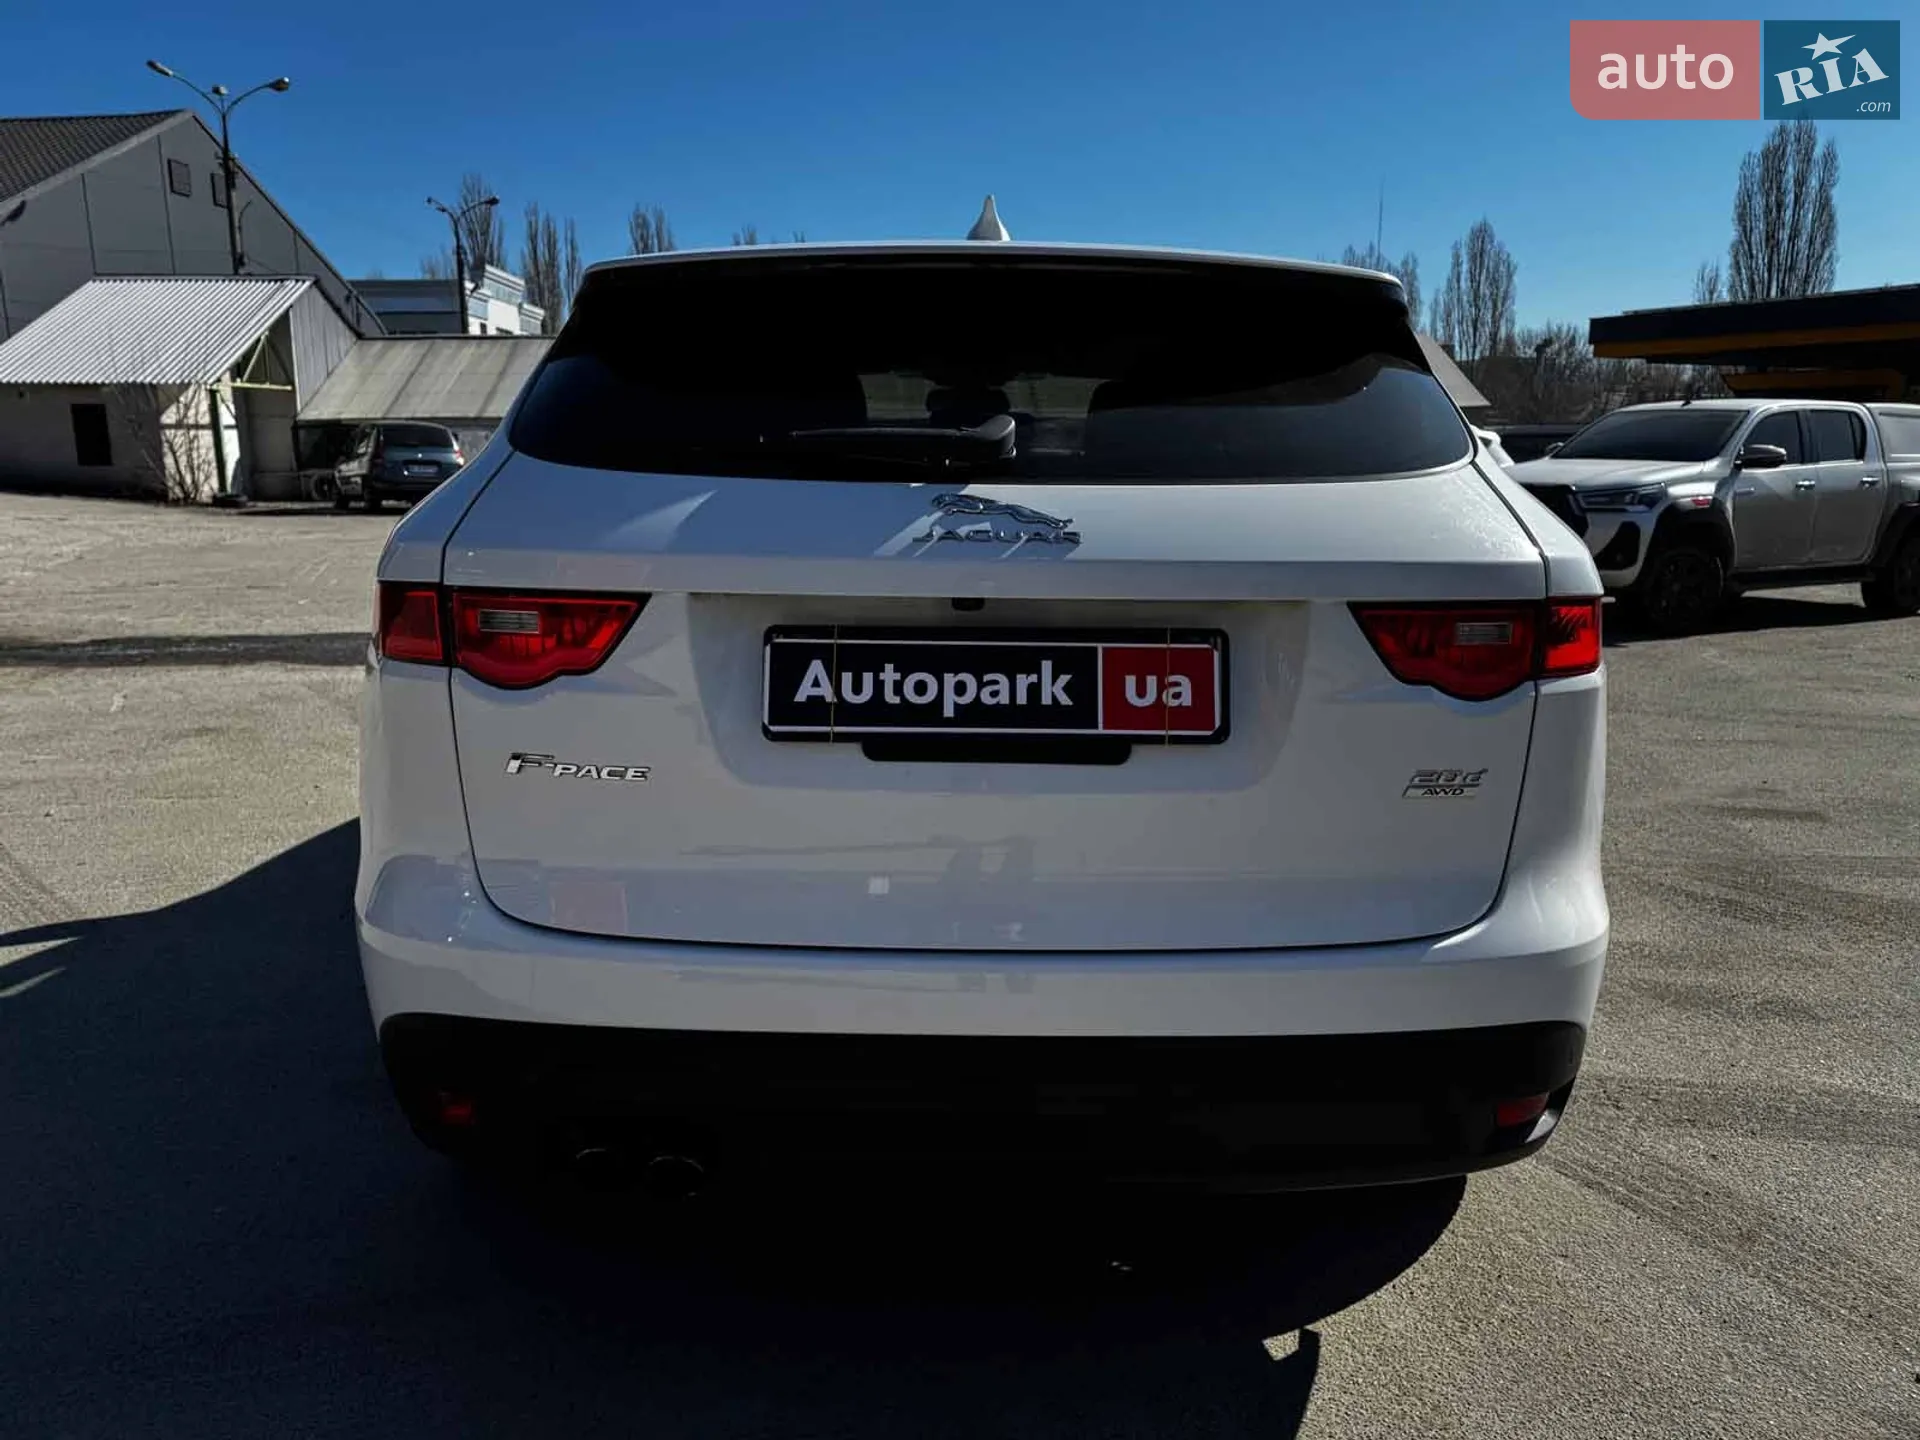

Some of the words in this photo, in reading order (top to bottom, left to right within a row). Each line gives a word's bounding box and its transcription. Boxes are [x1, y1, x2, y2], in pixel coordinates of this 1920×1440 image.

[912, 528, 1082, 543] JAGUAR
[793, 658, 1074, 718] Autopark
[1124, 673, 1193, 708] ua
[506, 752, 650, 781] F-PACE
[1421, 788, 1465, 796] AWD
